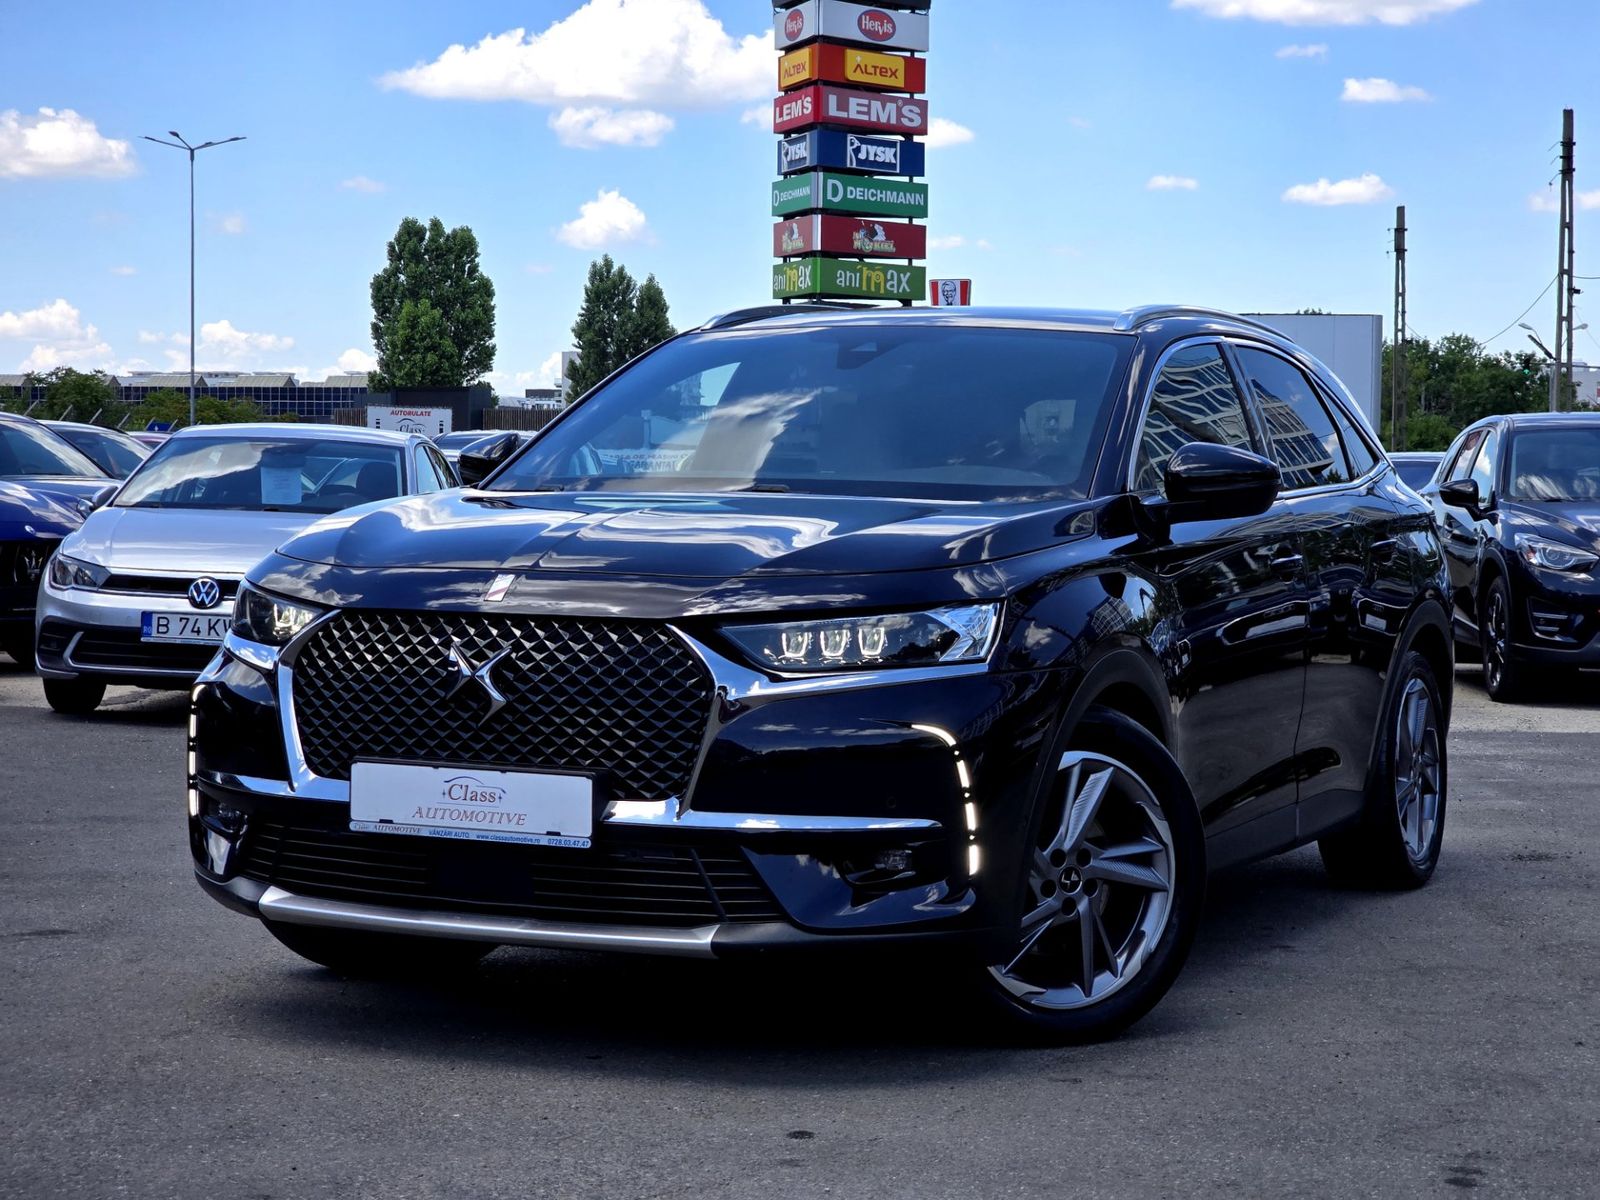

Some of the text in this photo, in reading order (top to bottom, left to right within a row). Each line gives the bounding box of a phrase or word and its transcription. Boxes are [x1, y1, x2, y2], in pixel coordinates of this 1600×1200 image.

[786, 18, 803, 34] Hervis
[861, 15, 894, 36] Hervis
[858, 144, 897, 163] JYSK
[780, 185, 811, 202] DEICHMANN
[826, 178, 924, 206] D DEICHMANN
[773, 264, 812, 292] animax
[836, 265, 911, 294] animax
[156, 616, 170, 635] B
[179, 617, 202, 636] 74
[448, 783, 497, 803] Class
[412, 806, 528, 826] AUTOMOTIVE
[373, 824, 422, 835] AUTOMOTIVE
[453, 831, 470, 839] AUTO
[476, 833, 541, 845] www.classautomotive.ro
